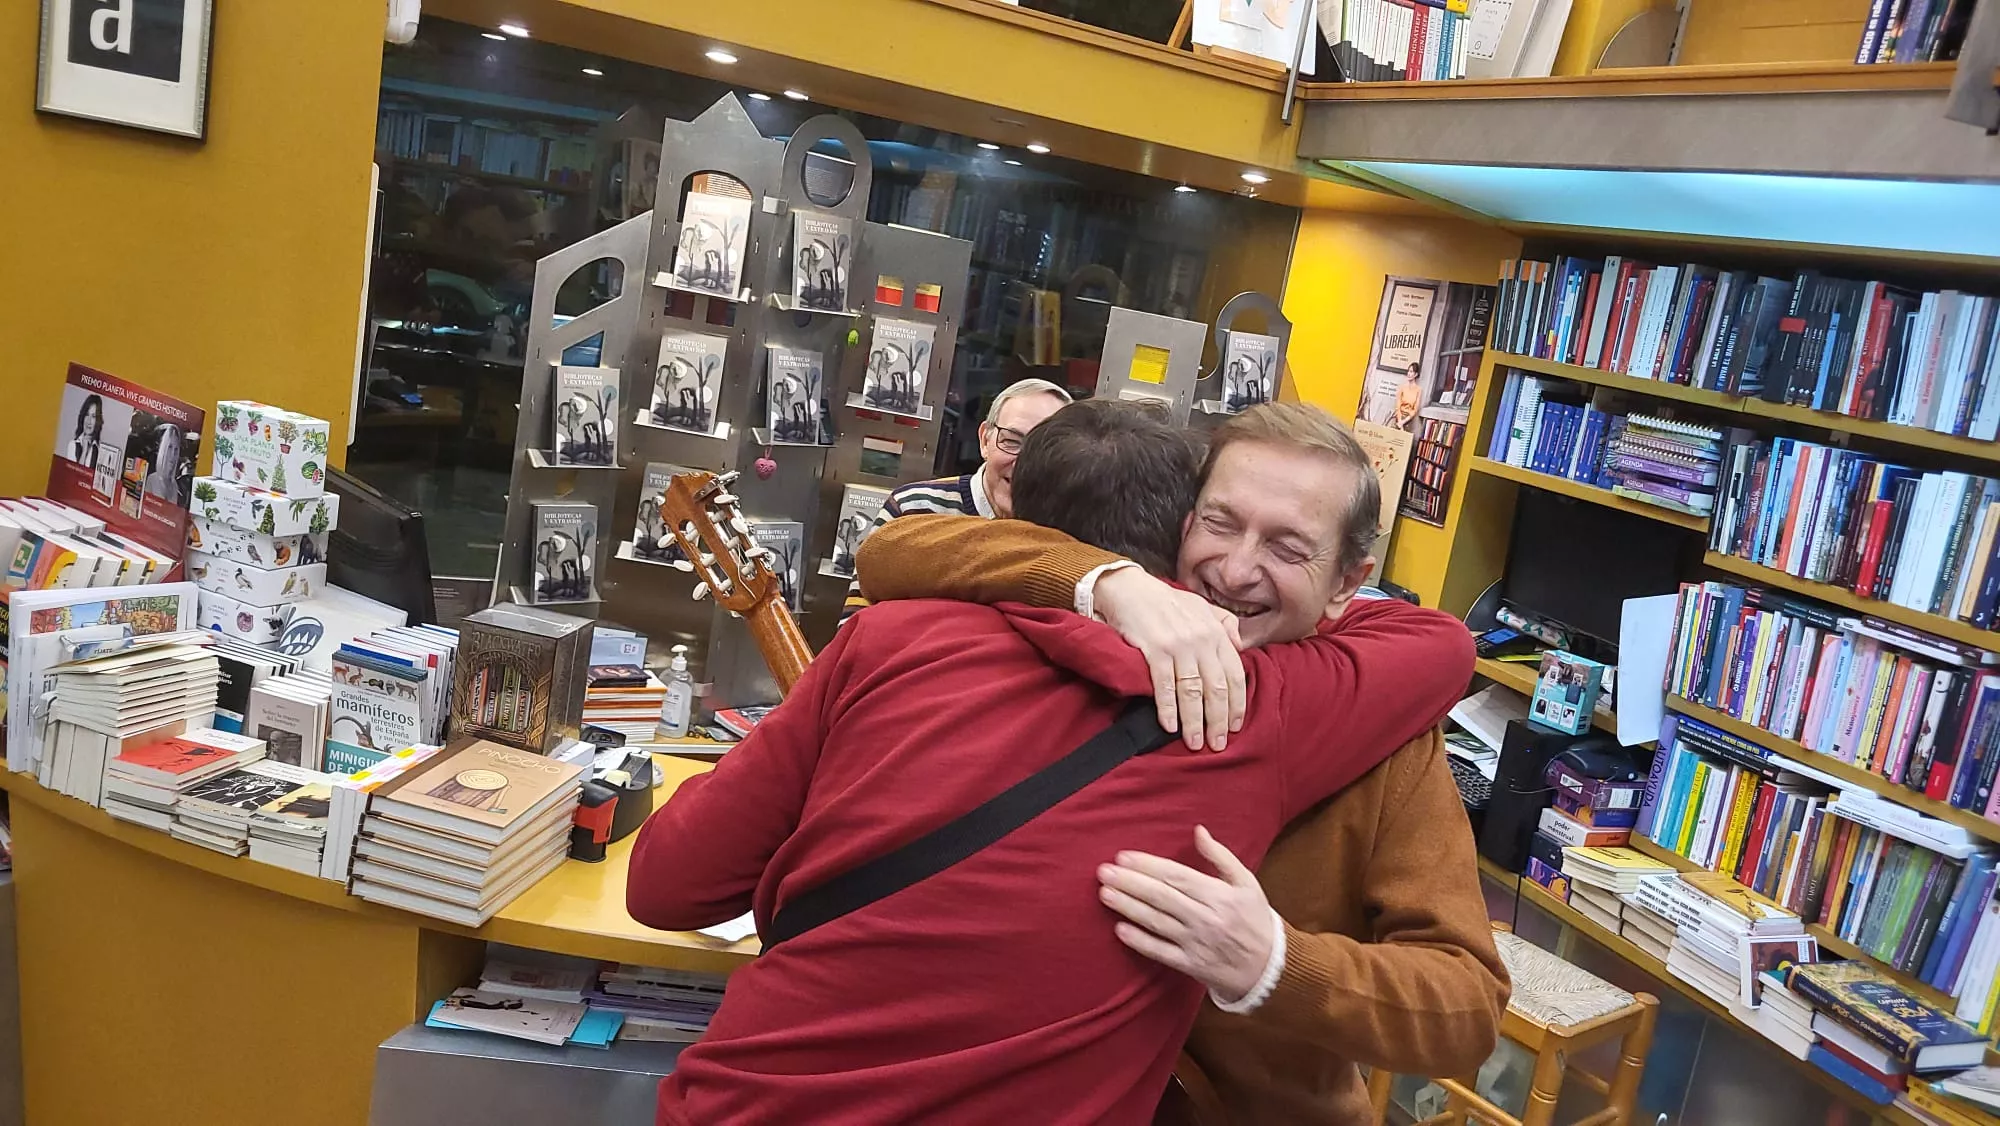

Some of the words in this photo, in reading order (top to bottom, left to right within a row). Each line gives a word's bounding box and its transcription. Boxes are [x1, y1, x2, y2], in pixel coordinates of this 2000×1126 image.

[1412, 11, 1422, 52] IGNATIEFF
[1418, 14, 1428, 54] IGNATIEFF
[1858, 31, 1876, 64] ESPACIO
[1384, 331, 1421, 348] LIBRERÍA
[81, 374, 102, 388] PREMIO
[126, 390, 138, 402] VIVE
[138, 396, 162, 411] GRANDES
[162, 404, 188, 421] HISTORIAS
[1621, 459, 1643, 468] AGENDA
[1626, 480, 1644, 488] AGENDA
[469, 632, 542, 657] BLACKWATER
[340, 690, 370, 703] Grandes
[336, 698, 414, 726] mamíferos
[371, 717, 404, 730] terrestres
[386, 728, 410, 740] España
[328, 762, 342, 772] DE
[478, 748, 560, 774] PINOCHO
[1643, 744, 1667, 807] AUTOAYUDA
[1547, 825, 1574, 842] menstrual
[1554, 820, 1571, 832] poder
